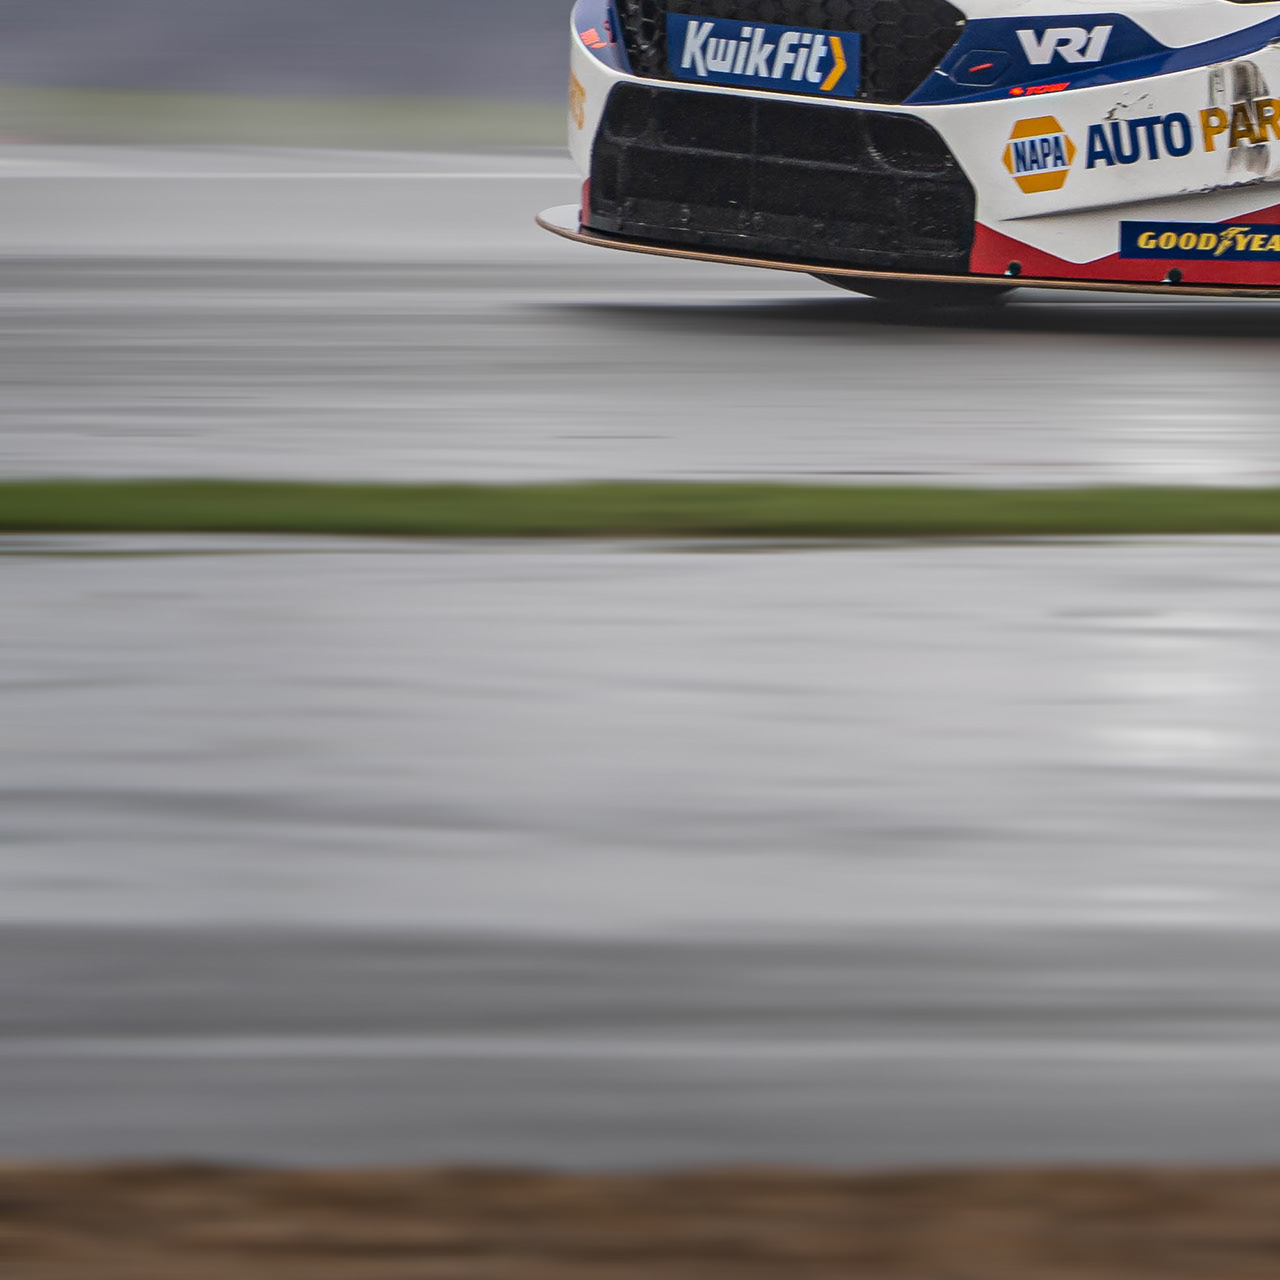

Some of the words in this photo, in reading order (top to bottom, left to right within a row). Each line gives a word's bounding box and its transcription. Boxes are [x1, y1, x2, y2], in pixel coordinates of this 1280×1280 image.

[1015, 25, 1113, 65] VR1
[1010, 135, 1071, 174] NAPA
[1085, 110, 1193, 169] AUTO
